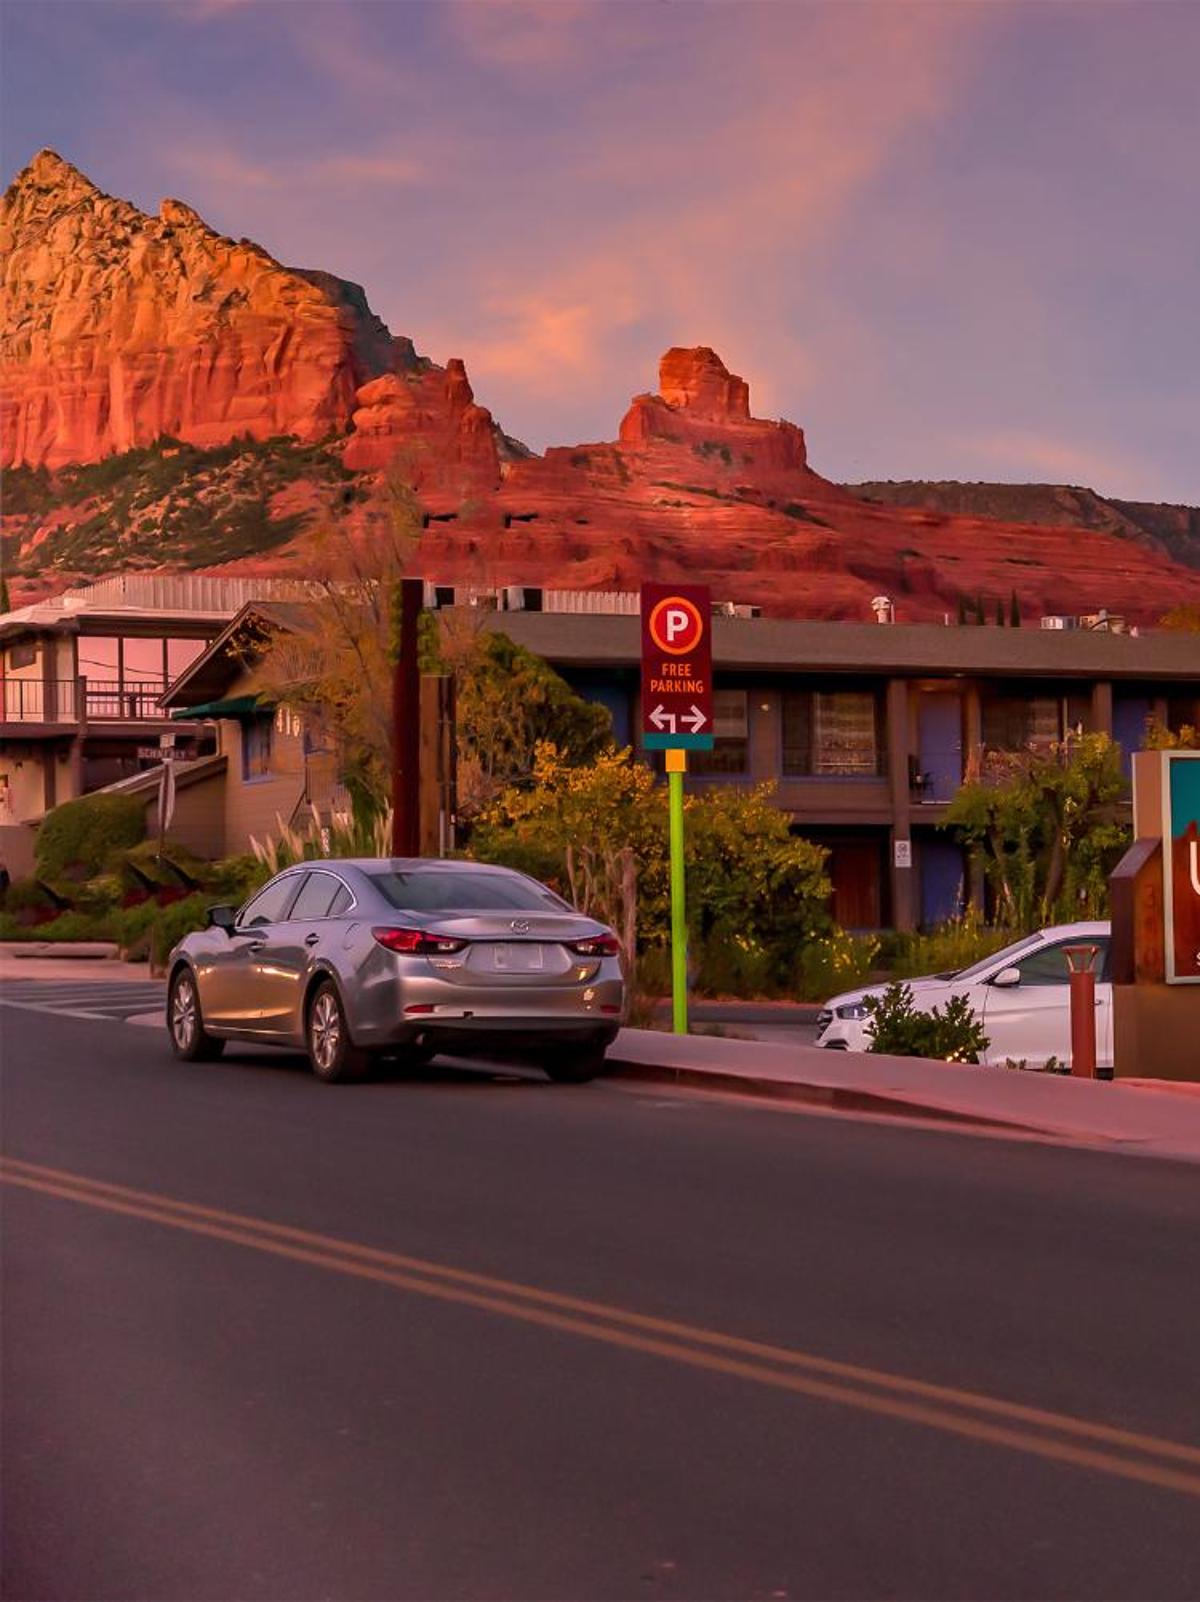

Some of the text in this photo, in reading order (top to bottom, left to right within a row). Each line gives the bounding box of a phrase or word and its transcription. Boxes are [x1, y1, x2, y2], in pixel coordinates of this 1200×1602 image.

[667, 610, 688, 641] P
[662, 664, 691, 676] FREE
[650, 680, 703, 693] PARKING
